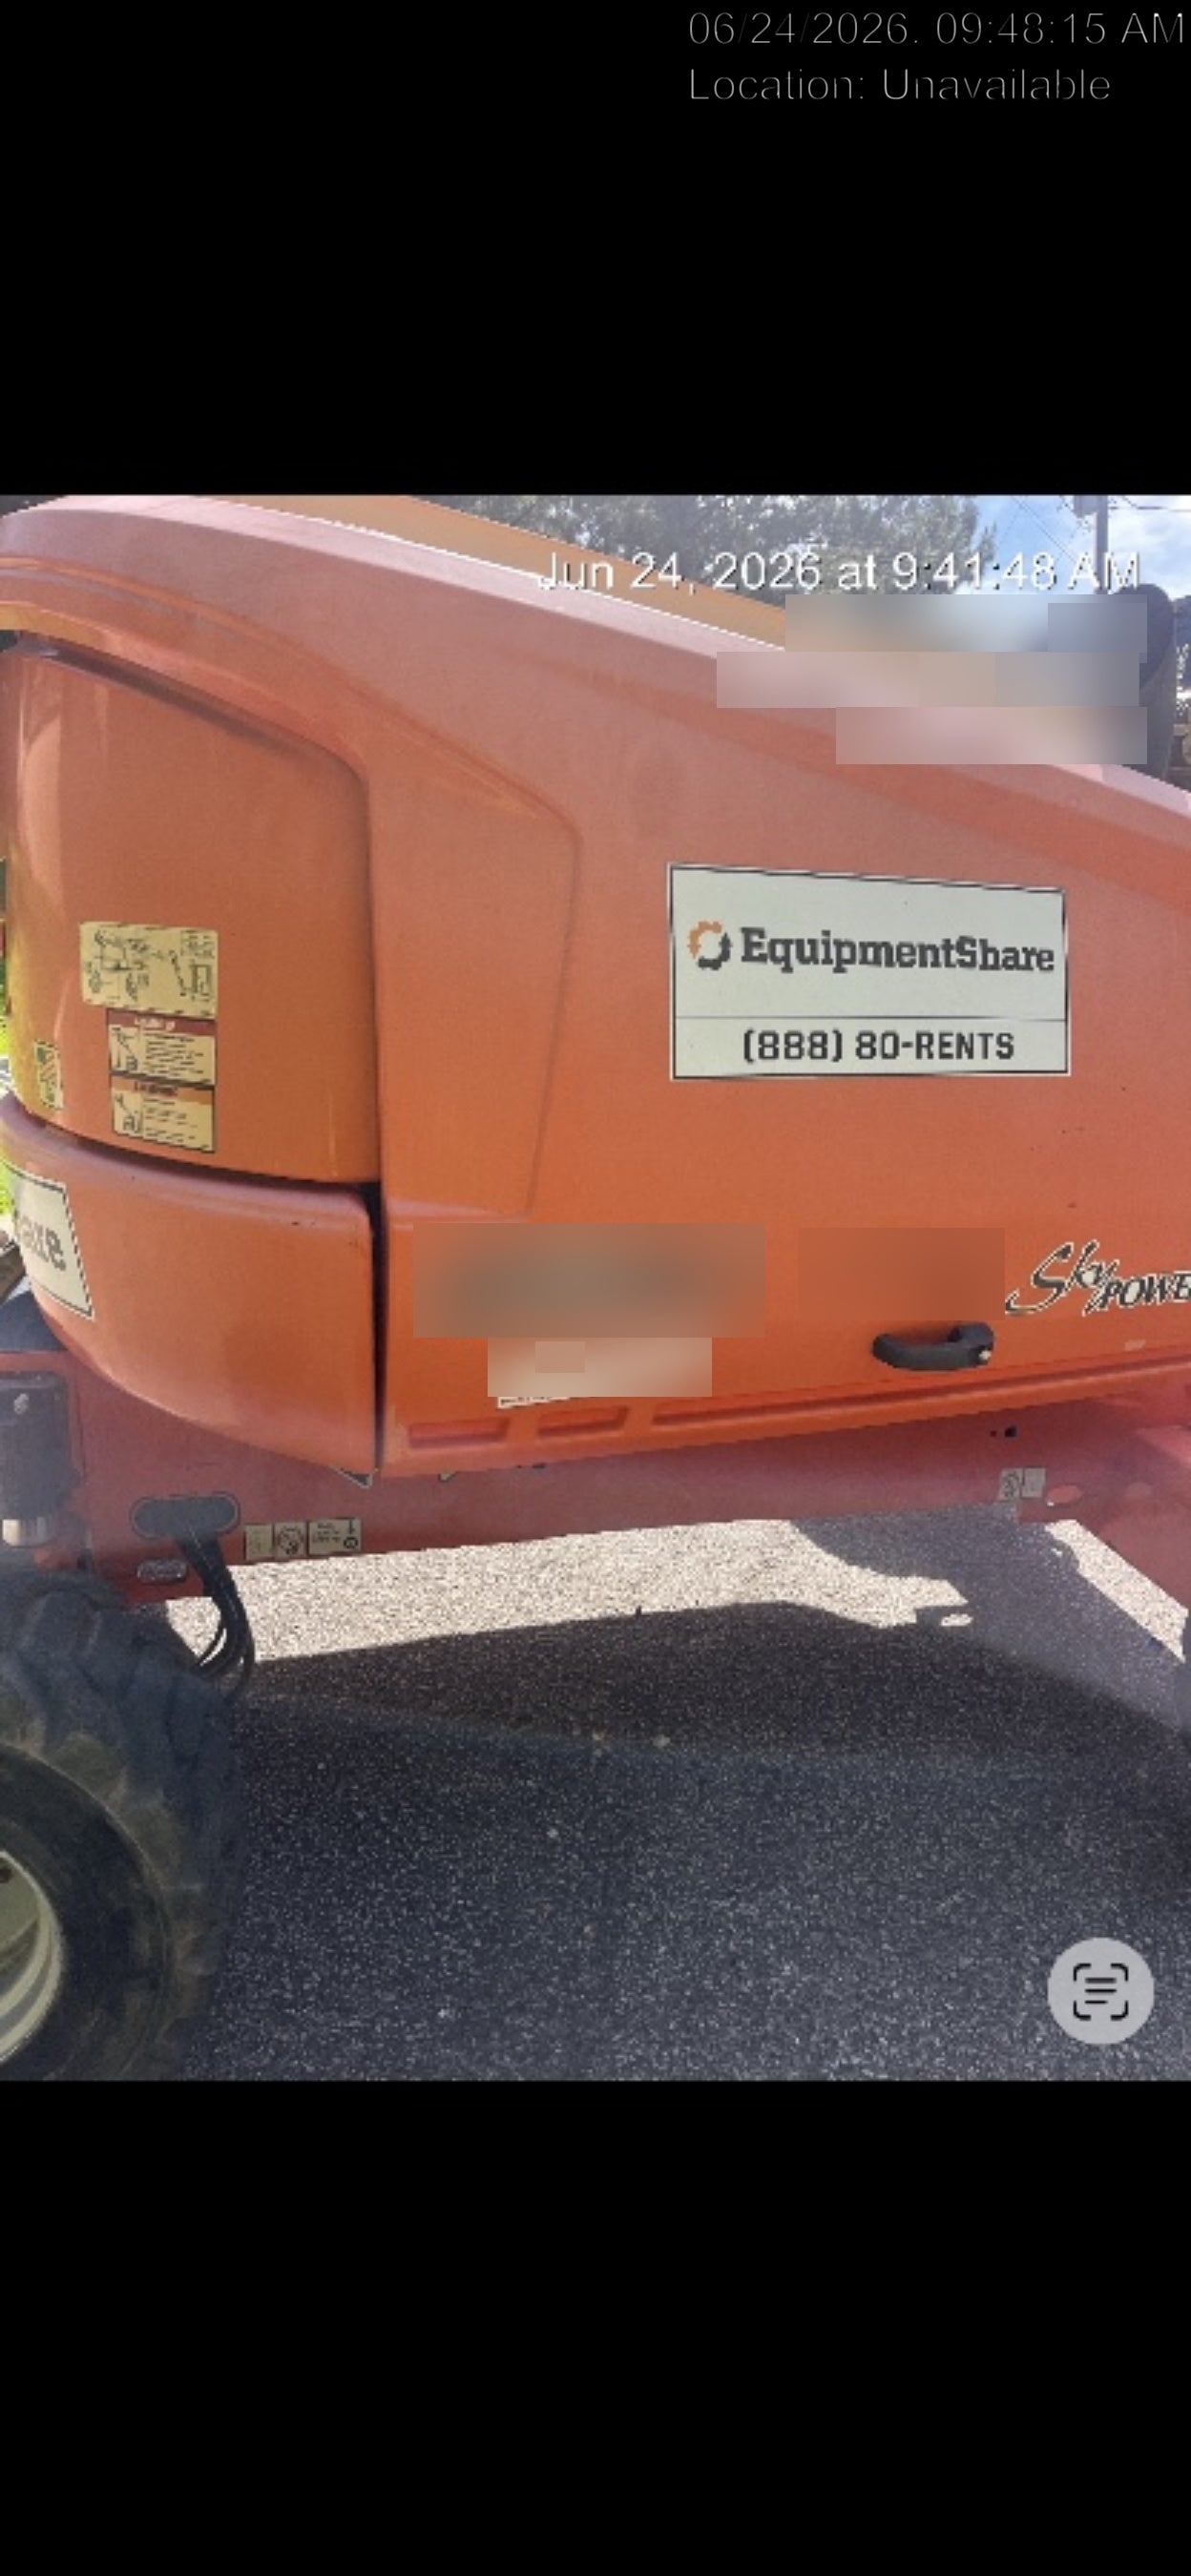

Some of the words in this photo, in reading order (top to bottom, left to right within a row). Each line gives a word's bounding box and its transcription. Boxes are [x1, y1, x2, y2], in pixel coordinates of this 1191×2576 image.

[740, 926, 1055, 974] EquipmentShare
[742, 1028, 844, 1063] (888)
[854, 1030, 1015, 1061] 80-RENTS
